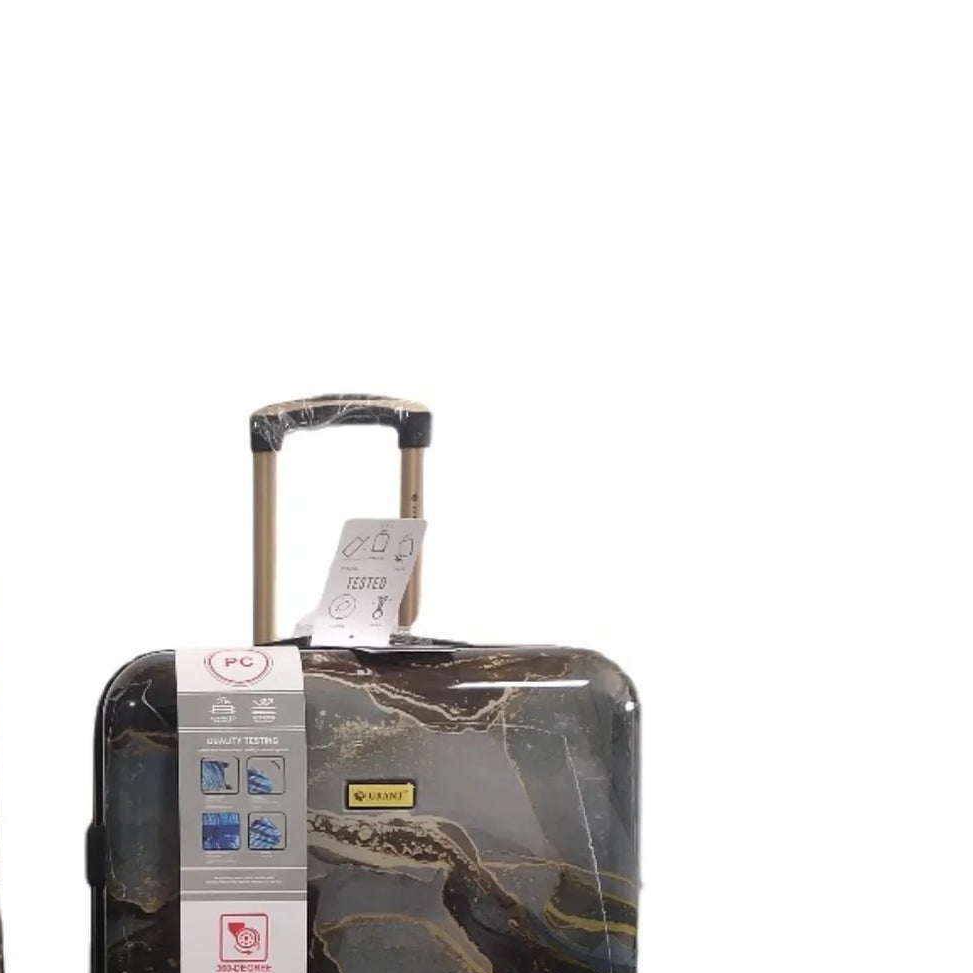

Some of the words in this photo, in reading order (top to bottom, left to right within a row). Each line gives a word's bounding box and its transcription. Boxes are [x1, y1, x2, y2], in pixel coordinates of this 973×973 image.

[347, 576, 387, 590] TESTED
[224, 656, 254, 668] PC
[206, 736, 242, 745] QUALITY
[244, 736, 279, 745] TESTING
